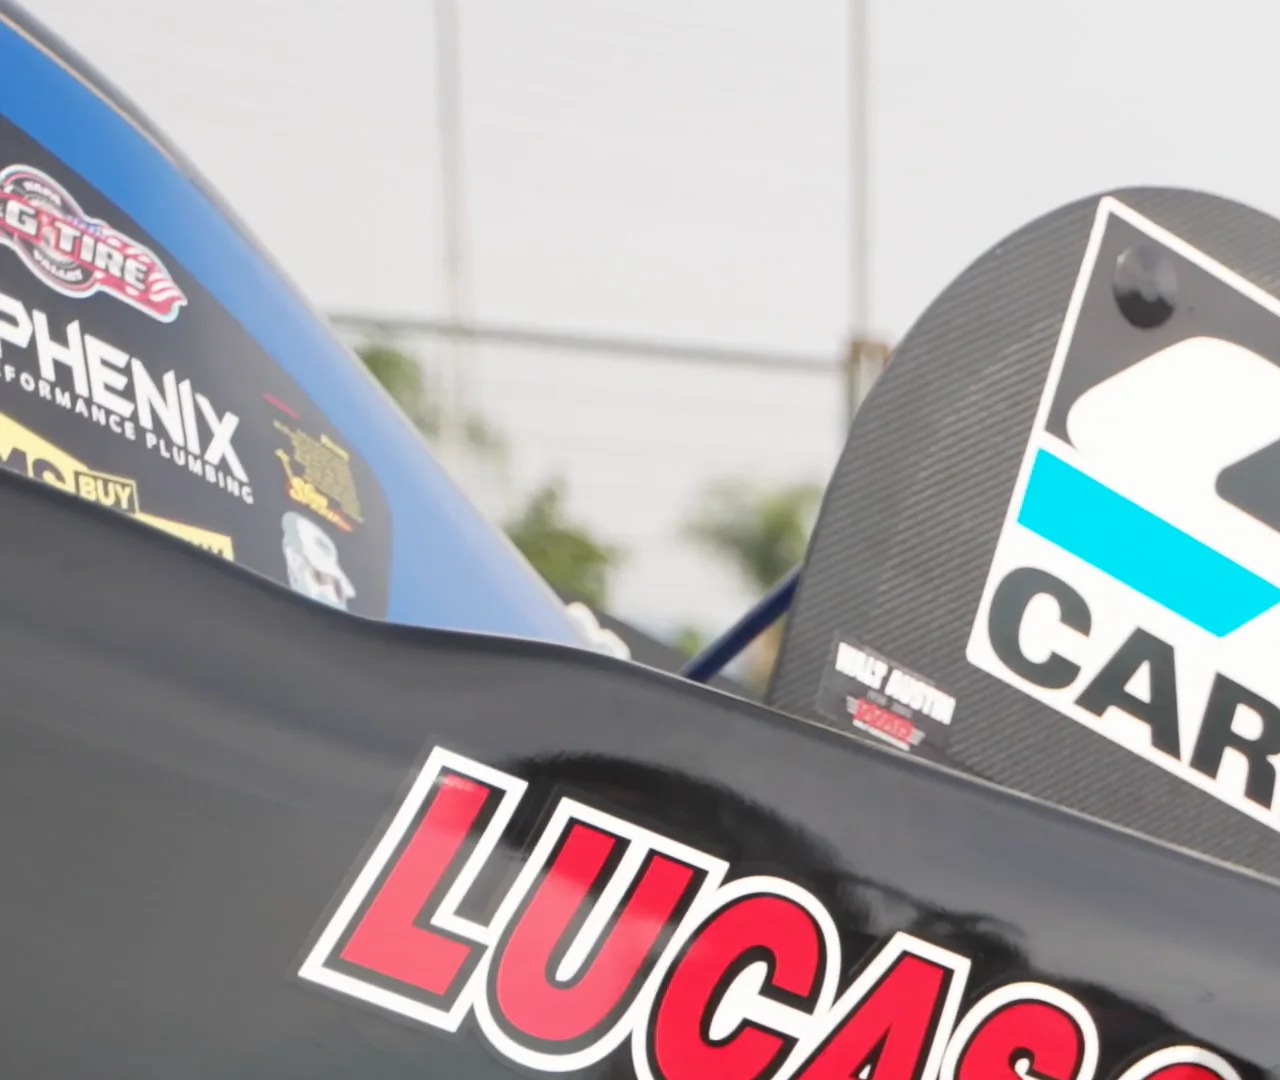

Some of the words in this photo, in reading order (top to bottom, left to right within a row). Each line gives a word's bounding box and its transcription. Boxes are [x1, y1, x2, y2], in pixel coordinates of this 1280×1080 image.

[55, 220, 149, 291] TIRE
[0, 292, 250, 483] PHENIX
[0, 363, 136, 440] FORMANCE
[145, 431, 254, 504] PLUMBING
[77, 473, 132, 510] BUY
